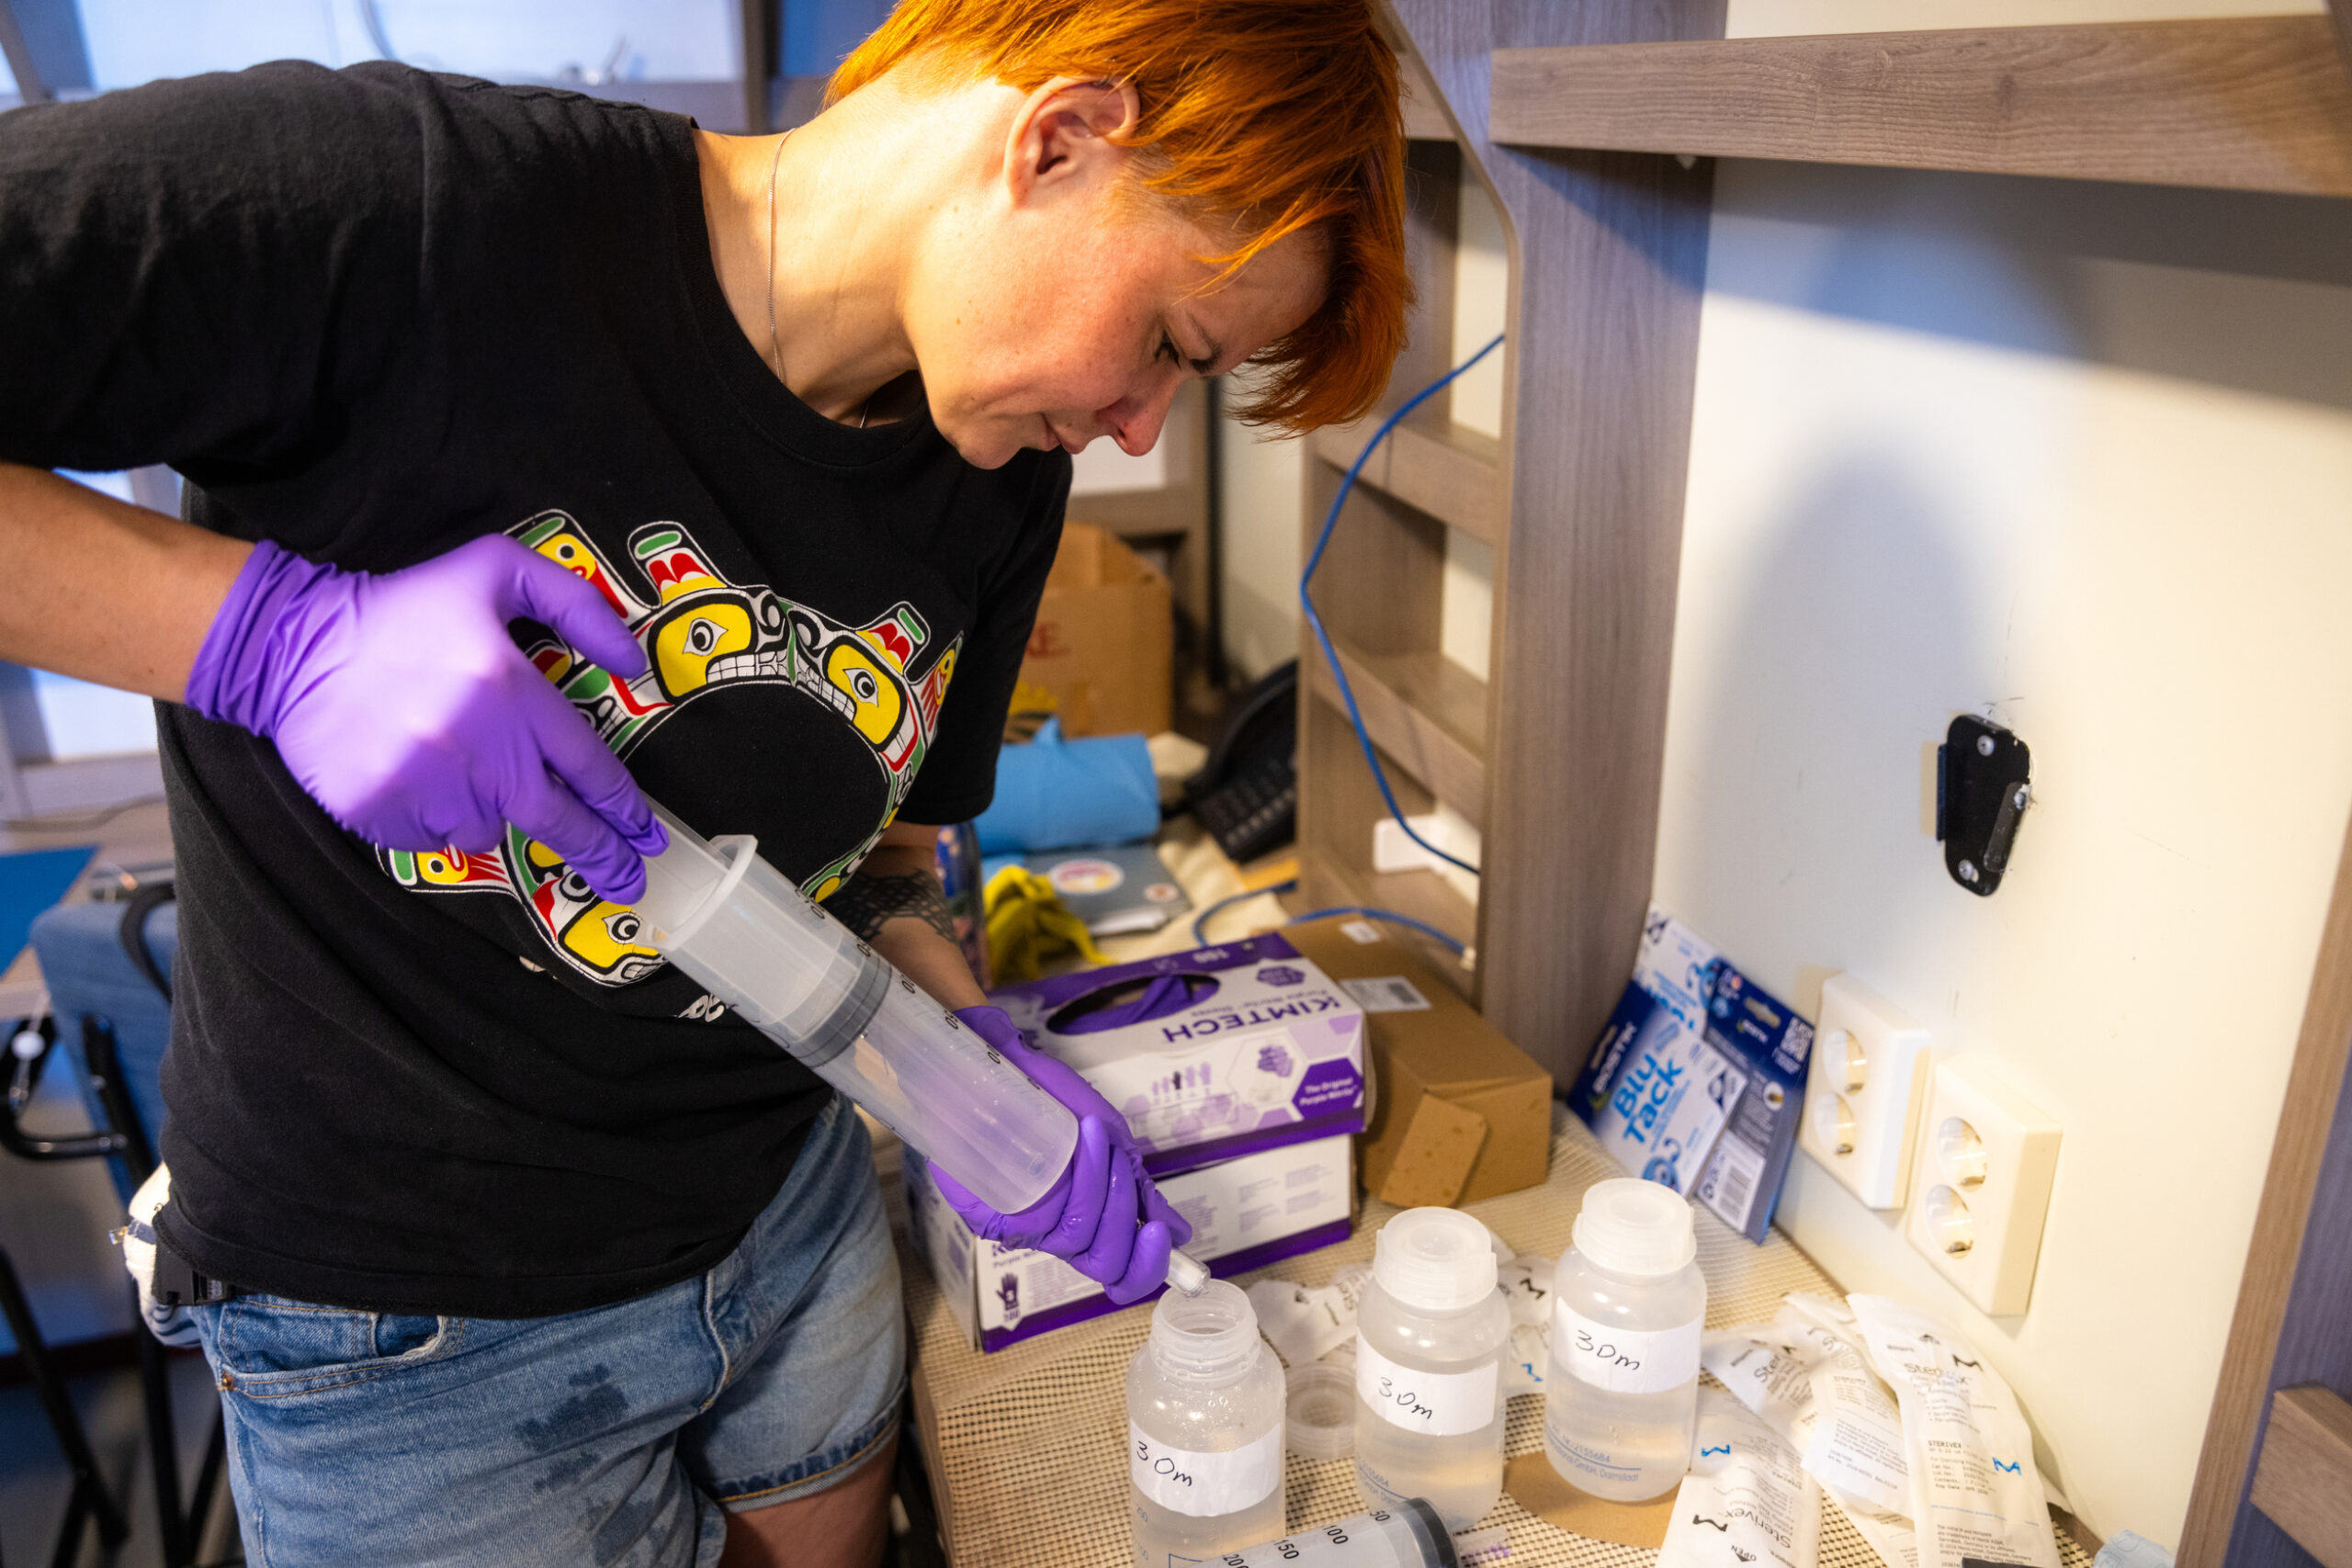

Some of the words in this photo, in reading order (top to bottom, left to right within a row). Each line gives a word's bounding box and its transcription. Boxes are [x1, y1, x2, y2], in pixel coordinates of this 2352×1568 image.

[1161, 997, 1341, 1043] KIMTECH
[1611, 1054, 1657, 1119] Blu
[1623, 1057, 1685, 1144] Tack
[1273, 1539, 1300, 1560] 150
[1323, 1525, 1350, 1545] 100
[1731, 1544, 1758, 1562] OPEN
